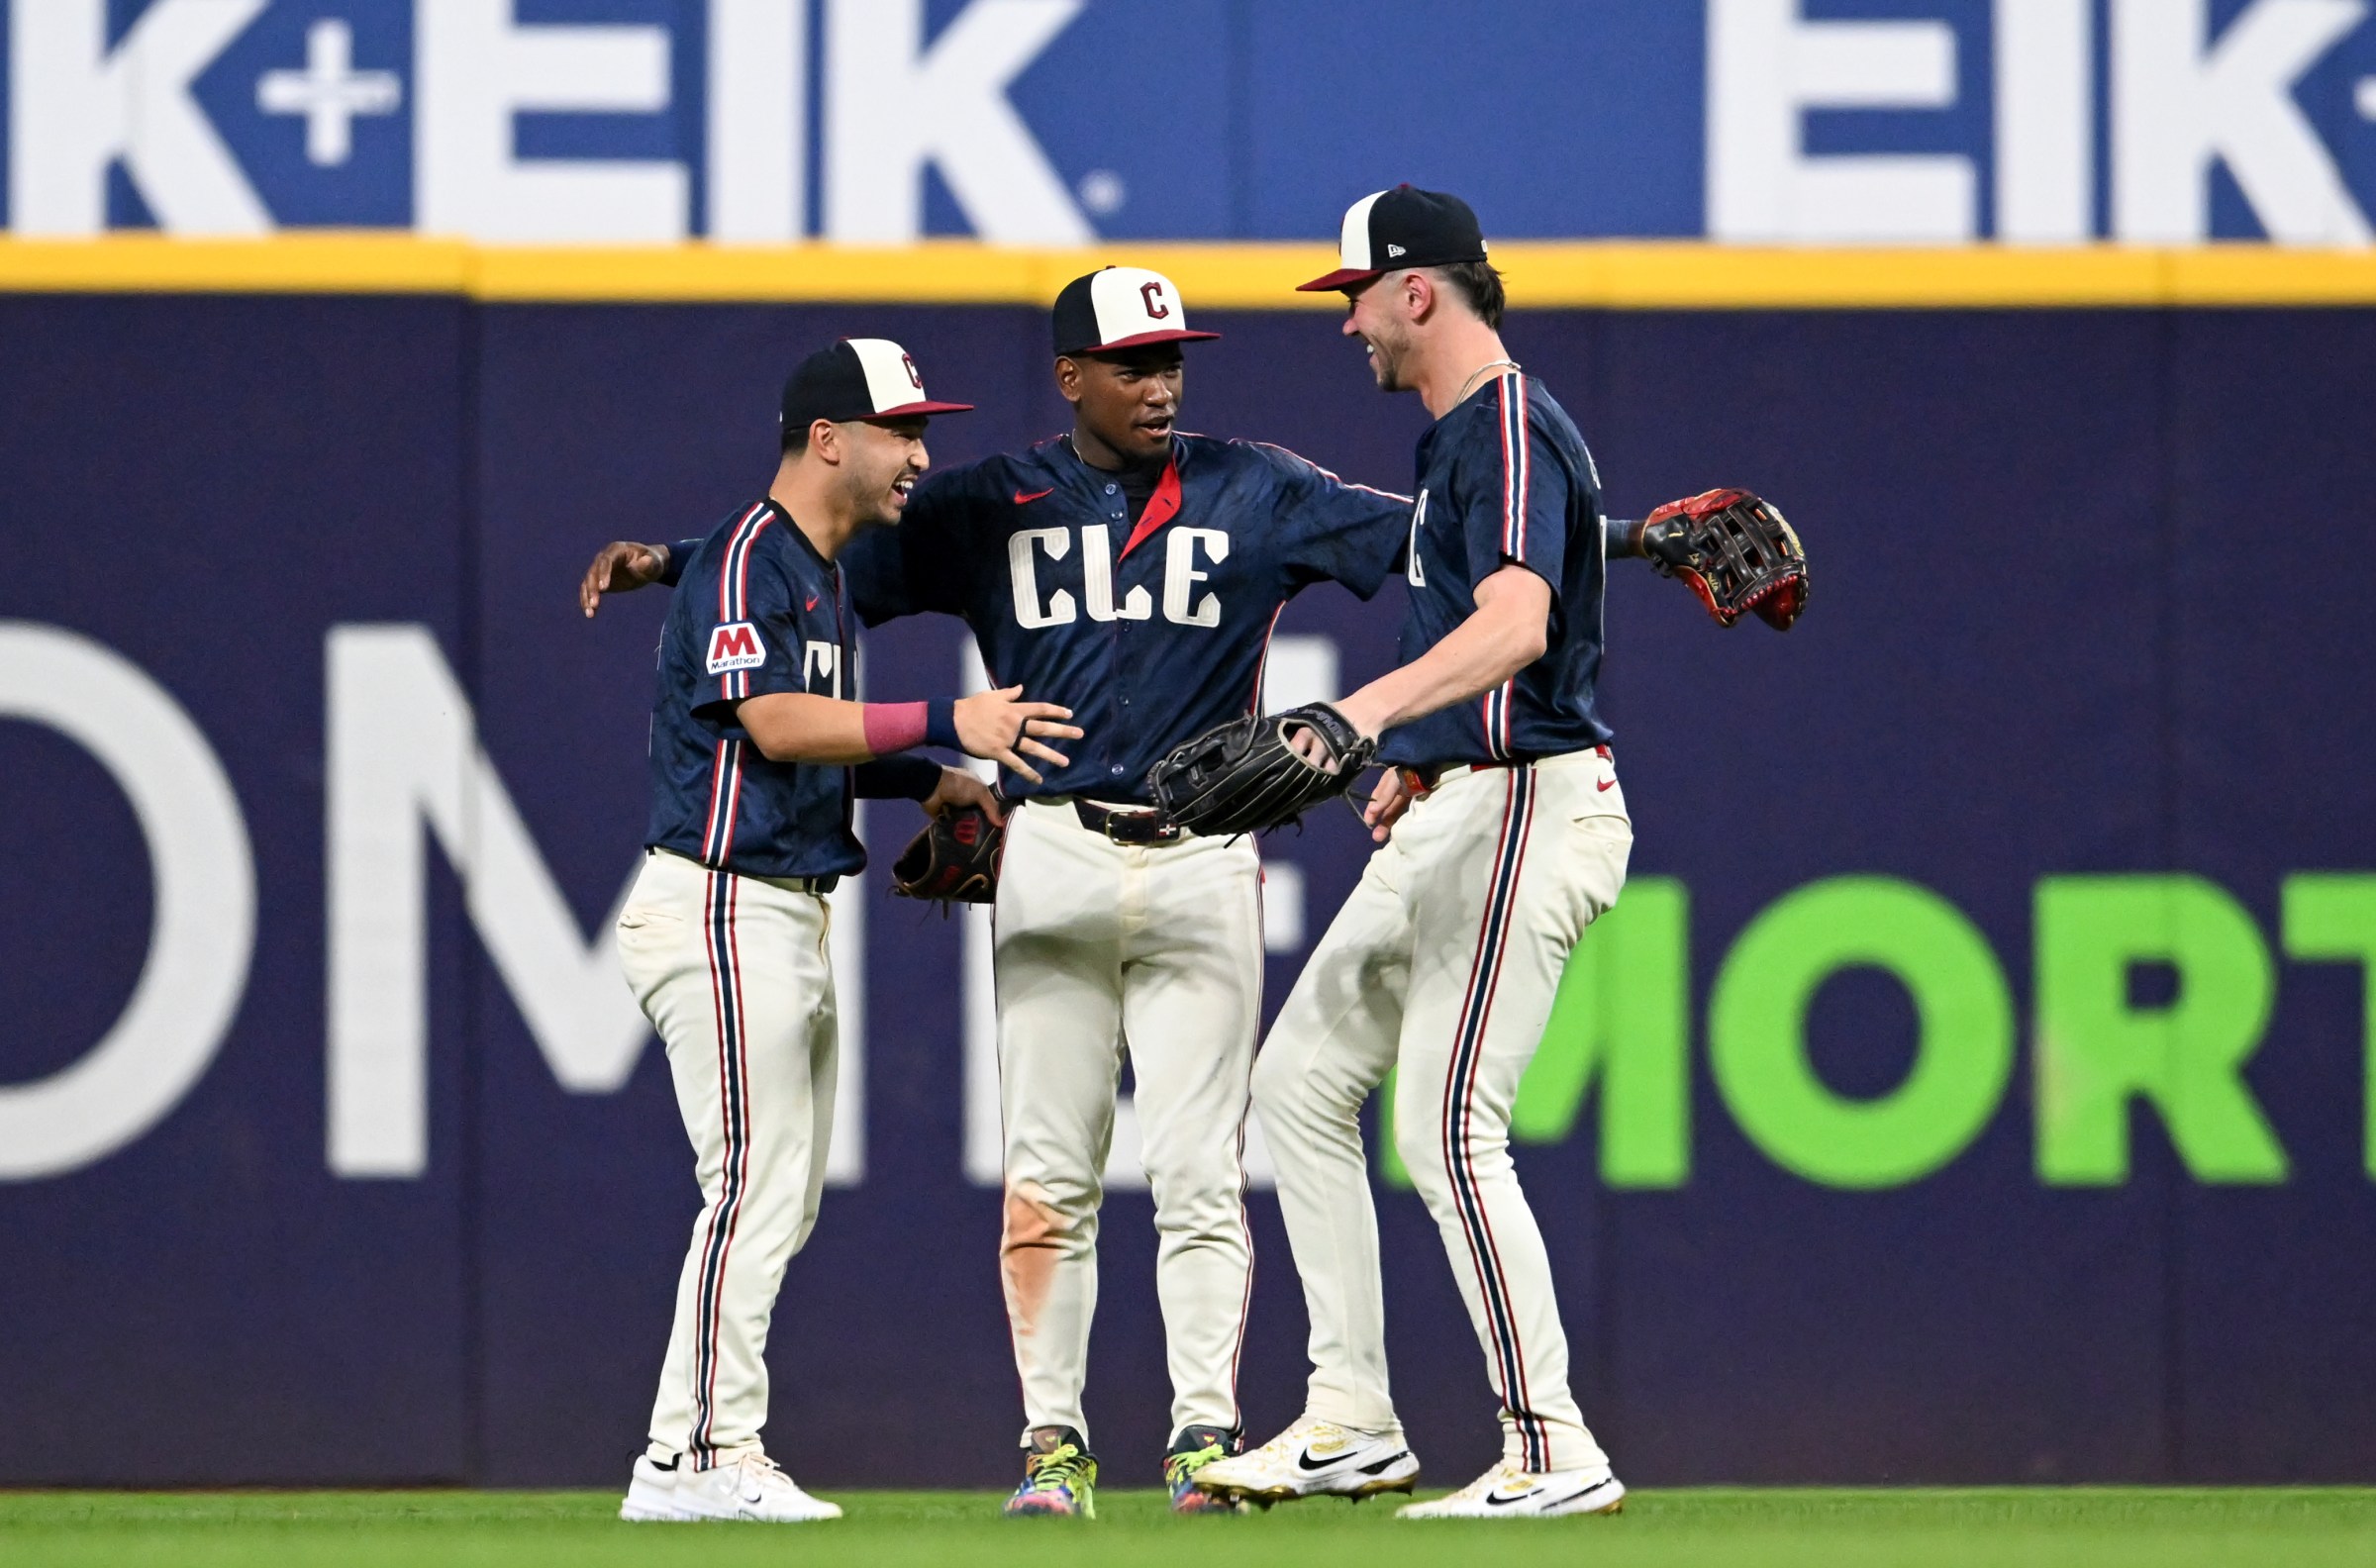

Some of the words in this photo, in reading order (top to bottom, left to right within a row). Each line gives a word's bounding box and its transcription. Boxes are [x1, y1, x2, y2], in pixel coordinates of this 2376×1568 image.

[1139, 281, 1169, 320] C
[1008, 523, 1230, 630] CLE
[712, 626, 758, 661] M
[711, 656, 760, 671] Marathon
